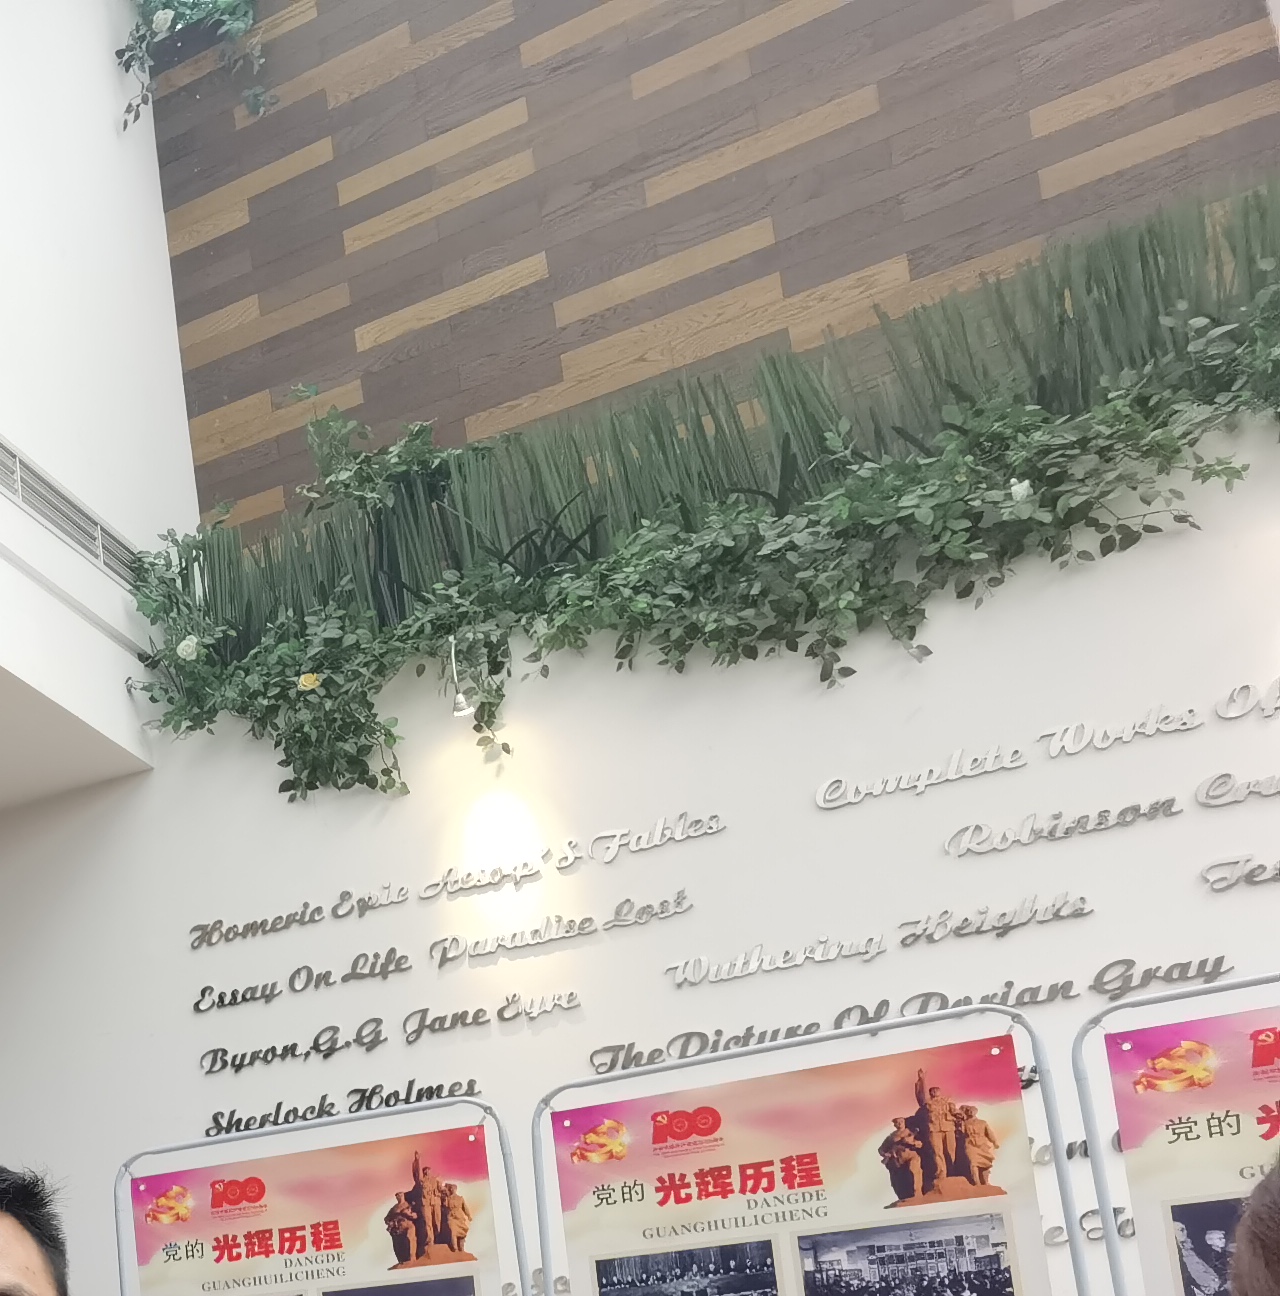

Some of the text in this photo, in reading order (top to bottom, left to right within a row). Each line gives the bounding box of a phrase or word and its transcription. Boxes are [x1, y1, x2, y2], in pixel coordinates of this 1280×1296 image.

[815, 744, 1028, 811] Complete
[1036, 703, 1205, 759] Works
[944, 795, 1183, 858] Robinson
[189, 901, 325, 951] Homeric
[331, 883, 410, 919] Epic
[588, 811, 727, 864] Fables
[192, 886, 694, 1014] Essay On Life Paradise Lost
[664, 890, 1096, 989] Wuthering Heights
[402, 1005, 492, 1046] Jane
[496, 987, 582, 1026] Eyre
[589, 1041, 666, 1075] The
[1088, 952, 1236, 1000] Gray
[204, 1076, 482, 1139] Sherlock Holmes
[1165, 1109, 1241, 1144] 党的
[592, 1152, 825, 1208] 党的 光辉历程
[746, 1188, 828, 1211] DANGDE
[161, 1219, 344, 1265] 党的 光辉历程
[642, 1205, 830, 1240] GUANGHUILICHENG
[201, 1266, 347, 1292] GUANGHUILICHENG
[284, 1251, 346, 1269] DANGDE
